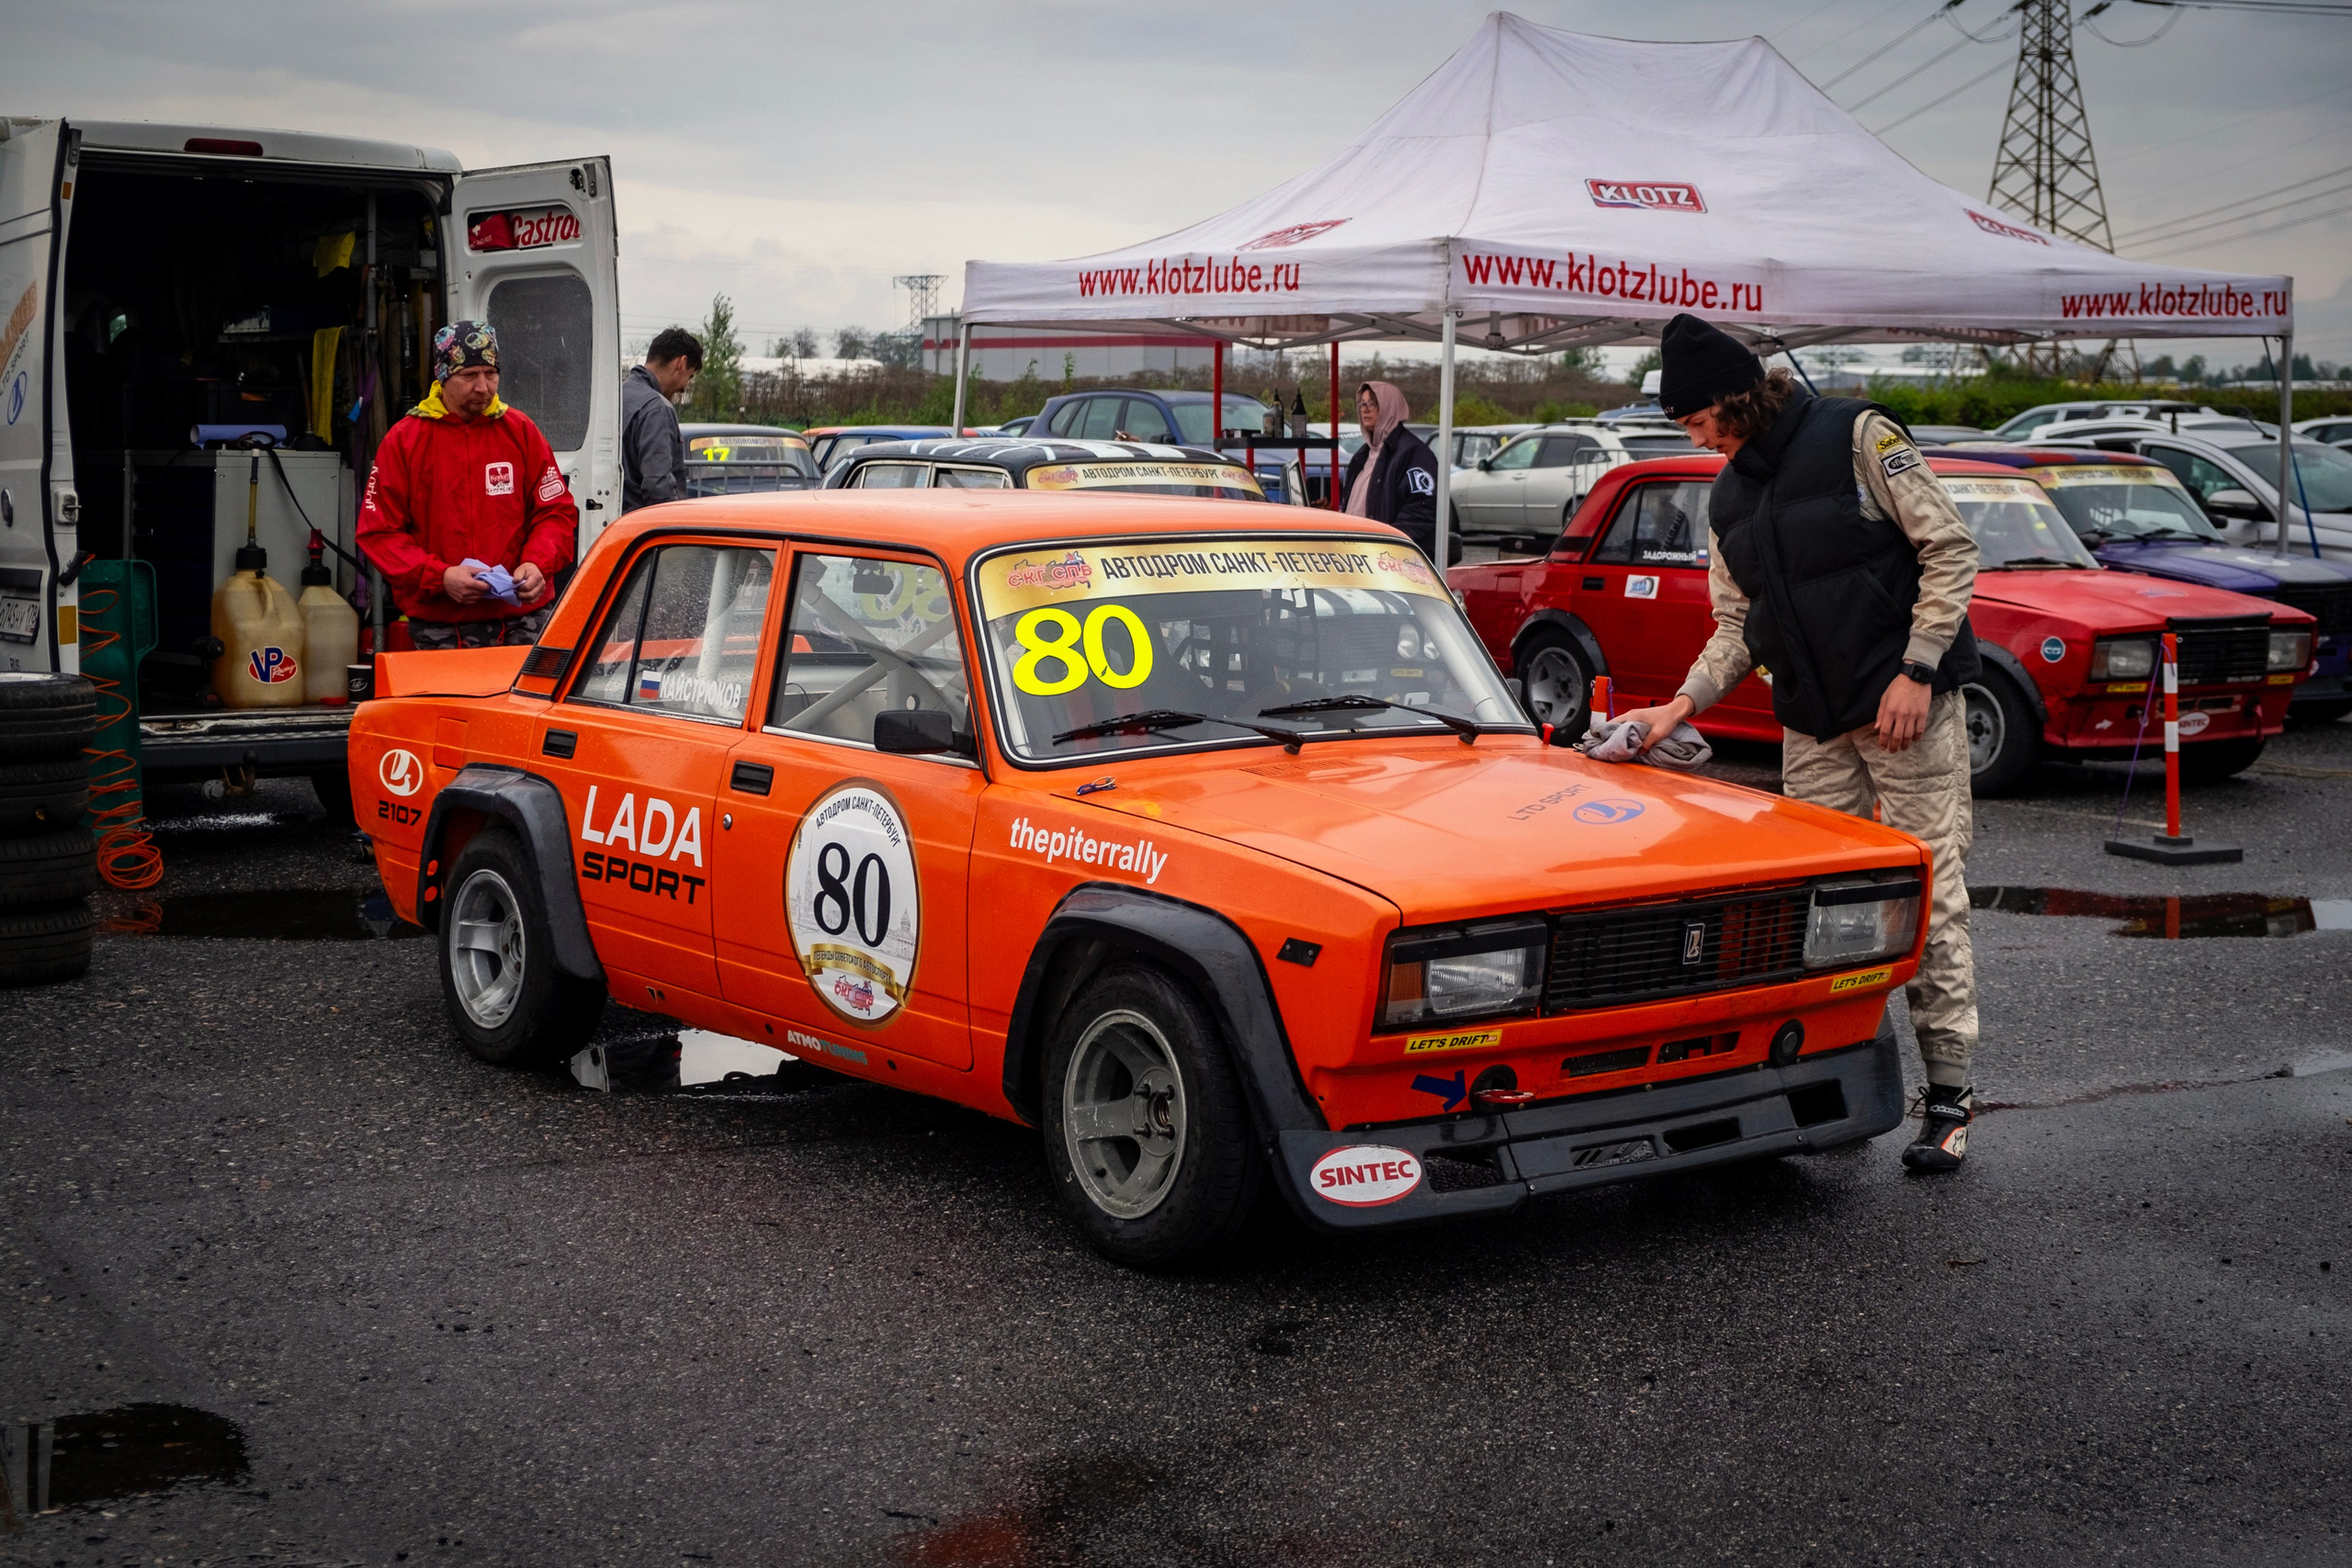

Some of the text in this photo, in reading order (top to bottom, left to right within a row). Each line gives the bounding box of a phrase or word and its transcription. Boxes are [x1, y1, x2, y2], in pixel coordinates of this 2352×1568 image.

[1598, 184, 1694, 206] KLOTZ
[1078, 256, 1301, 298] www.klotzlube.ru
[1462, 252, 1762, 312] www.klotzlube.ru
[2061, 282, 2288, 318] www.klotzlube.ru
[702, 446, 730, 462] 17
[1081, 466, 1219, 479] АВТОДРОМ САНКТ-ПЕТЕРБУРГ
[1100, 551, 1374, 580] АВТОДРОМ САНКТ-ПЕТЕРБУРГ
[1642, 550, 1698, 562] ЗАДОРОЖНЫЙ
[1007, 567, 1046, 588] СКГ
[250, 646, 284, 683] VP
[1012, 604, 1154, 696] 80
[271, 664, 297, 679] Racing
[660, 671, 742, 709] КАЙСТРЮКОВ
[378, 799, 423, 827] 2107
[1507, 784, 1592, 821] LTD SPORT
[581, 785, 704, 868] LADA
[815, 796, 851, 829] АВТОДРОМ
[852, 795, 901, 848] САНКТ-ПЕТЕРБУРГ
[1010, 817, 1169, 885] thepiterrally
[581, 851, 707, 905] SPORT
[813, 841, 891, 948] 80
[834, 950, 863, 967] СОВЕТСКОГО
[863, 957, 893, 986] АВТОСПОРТА
[1833, 976, 1858, 990] LET'S
[1858, 971, 1884, 985] DRIFT
[1408, 1037, 1448, 1050] LET'S
[1449, 1033, 1489, 1048] DRIFT
[1318, 1159, 1415, 1189] SINTEC
